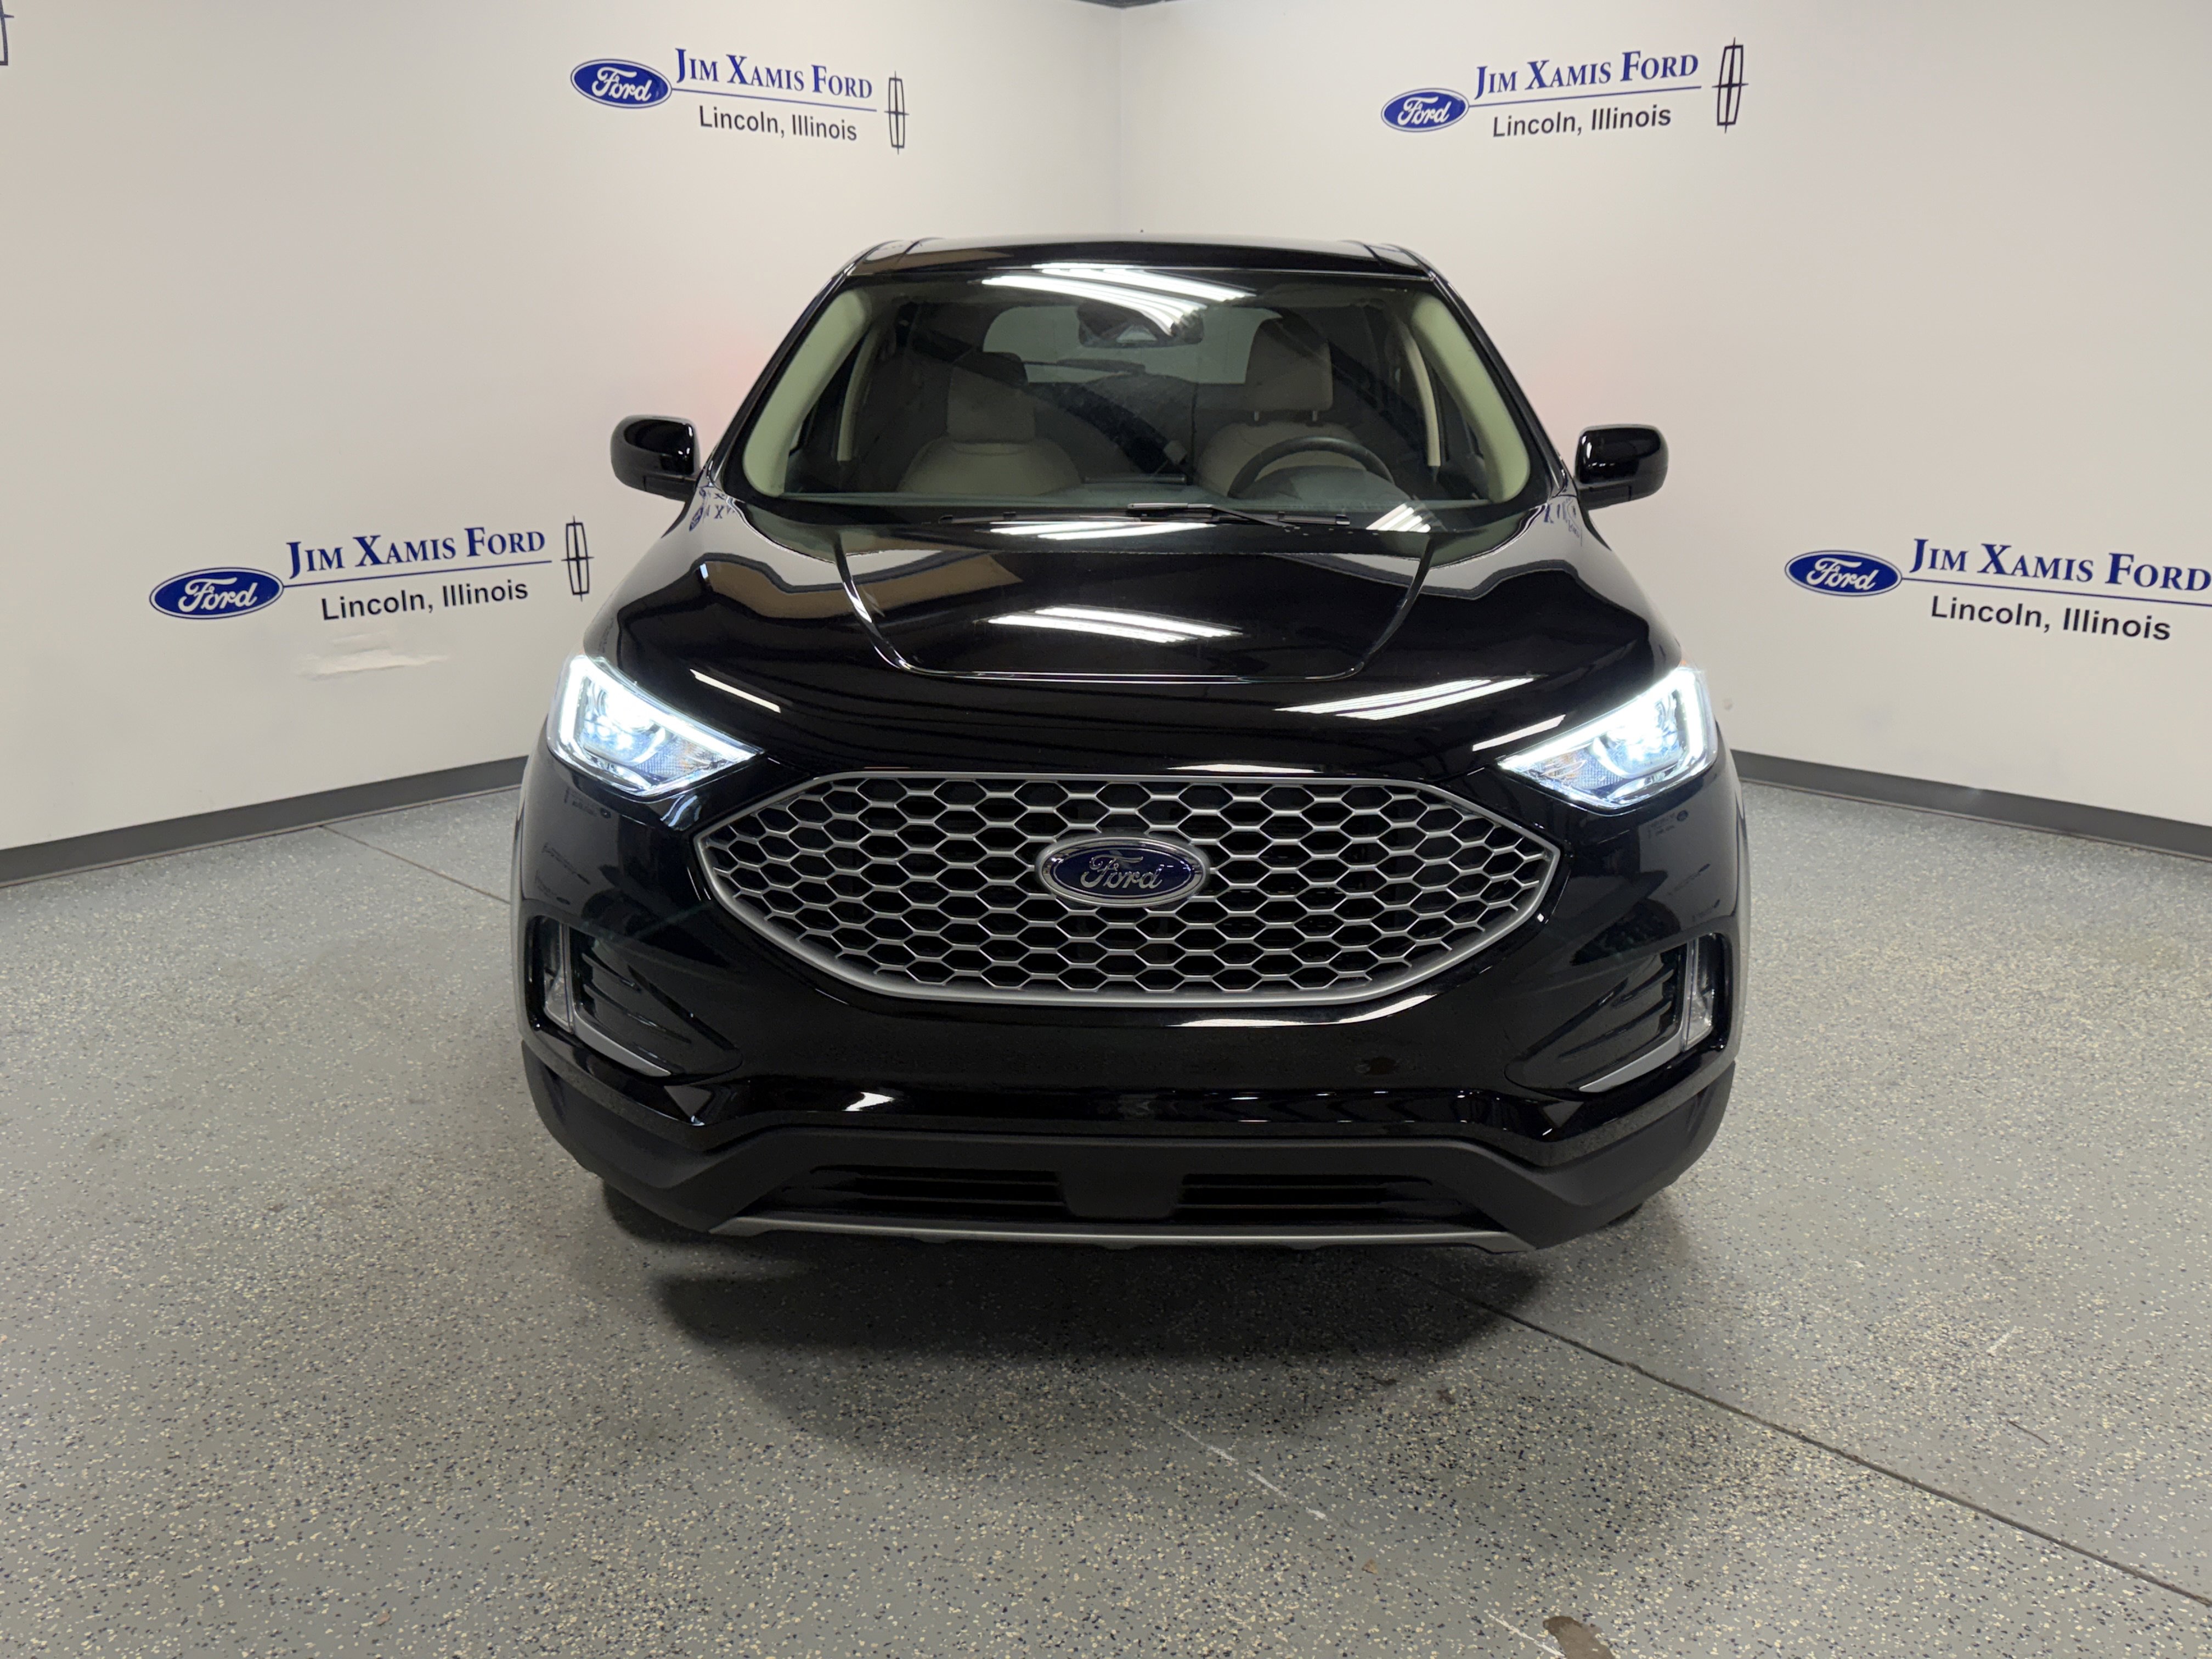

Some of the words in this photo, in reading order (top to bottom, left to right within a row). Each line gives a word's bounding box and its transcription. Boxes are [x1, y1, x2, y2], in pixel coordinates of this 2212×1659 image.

[591, 66, 652, 101] Ford
[675, 48, 719, 84] JIM
[726, 54, 804, 92] XAMIS
[811, 64, 872, 99] FORD
[1474, 65, 1517, 100] JIM
[1524, 59, 1611, 91] XAMIS
[1620, 50, 1699, 82] FORD
[699, 105, 785, 138] Lincoln,
[792, 114, 857, 141] Illinois
[1397, 96, 1452, 126] Ford
[1493, 111, 1582, 138] Lincoln,
[1591, 104, 1671, 131] Illinois
[286, 541, 346, 580] JIM
[352, 534, 456, 568] XAMIS
[464, 527, 545, 558] FORD
[1909, 538, 1969, 573] JIM
[1976, 543, 2094, 583] XAMIS
[2104, 552, 2212, 591] FORD
[1806, 557, 1879, 591] Ford
[178, 577, 258, 612] Ford
[321, 589, 433, 621] Lincoln,
[442, 579, 528, 607] Illinois
[1931, 595, 2050, 633] Lincoln,
[2063, 607, 2171, 641] Illinois
[1080, 855, 1163, 889] Ford
